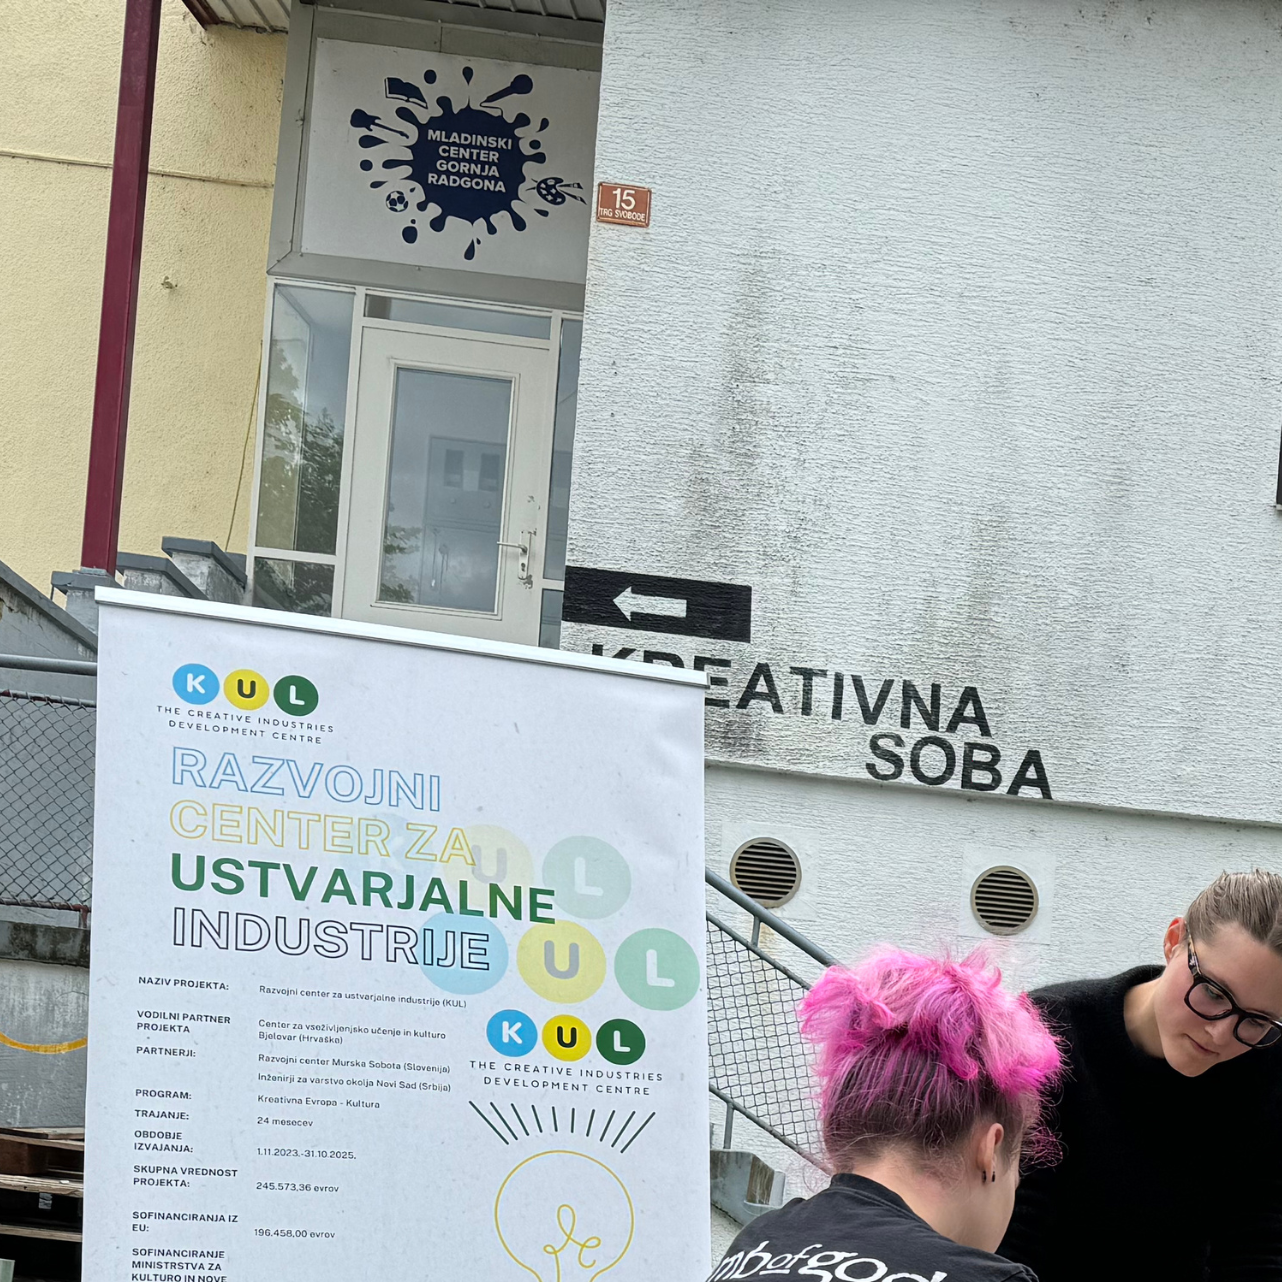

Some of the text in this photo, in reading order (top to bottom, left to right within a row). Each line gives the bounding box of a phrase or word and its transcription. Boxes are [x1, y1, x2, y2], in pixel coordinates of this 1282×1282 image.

[428, 130, 512, 150] MLADINSKI
[439, 145, 499, 162] CENTER
[436, 159, 499, 177] GORNJA
[428, 173, 505, 193] RADGONA
[612, 188, 636, 209] 15
[599, 207, 645, 222] TRG SVOBODE
[591, 643, 992, 738] EATIVNA
[157, 706, 334, 733] THE CREATIVE INDUSTRIES
[168, 719, 322, 745] DEVELOPMENT CENTRE
[866, 732, 1054, 800] SOBA
[172, 746, 441, 812] RAZVOJNI
[170, 800, 476, 865] CENTER ZA
[172, 852, 556, 925] USTVARJALNE
[172, 908, 490, 972] INDUSTRIJE
[139, 977, 229, 990] NAZIV PROJEKTA:
[259, 985, 298, 996] Razvojni
[300, 989, 330, 998] center
[398, 996, 440, 1006] industrije
[442, 999, 467, 1008] (KUL)
[137, 1010, 231, 1024] VODILNI PARTNER
[137, 1023, 190, 1033] PROJEKTA
[136, 1046, 196, 1058] PARTNERJI:
[259, 1054, 450, 1073] Razvojni center Murska Sobota (Slovenija)
[469, 1060, 663, 1081] THE CREATIVE INDUSTRIES
[258, 1072, 294, 1084] Inženirji
[310, 1076, 344, 1086] varstvo
[346, 1077, 374, 1088] okolja
[376, 1079, 396, 1088] Novi
[399, 1081, 416, 1090] Sad
[419, 1082, 451, 1092] (Srbija)
[484, 1076, 650, 1096] DEVELOPMENT CENTRE
[135, 1089, 192, 1099] PROGRAM:
[135, 1109, 189, 1120] TRAJANJE:
[134, 1130, 182, 1140] OBDOBJE
[134, 1142, 193, 1153] IZVAJANJA:
[134, 1165, 238, 1177] SKUPNA VREDNOST
[133, 1178, 190, 1188] PROJEKTA:
[132, 1211, 238, 1223] SOFINANCIRANJA IZ
[132, 1224, 149, 1232] EU:
[132, 1248, 225, 1259] SOFINANCIRANJE
[132, 1261, 222, 1271] MINISTRSTVA ZA
[132, 1274, 182, 1282] KULTURO
[184, 1275, 195, 1282] IN
